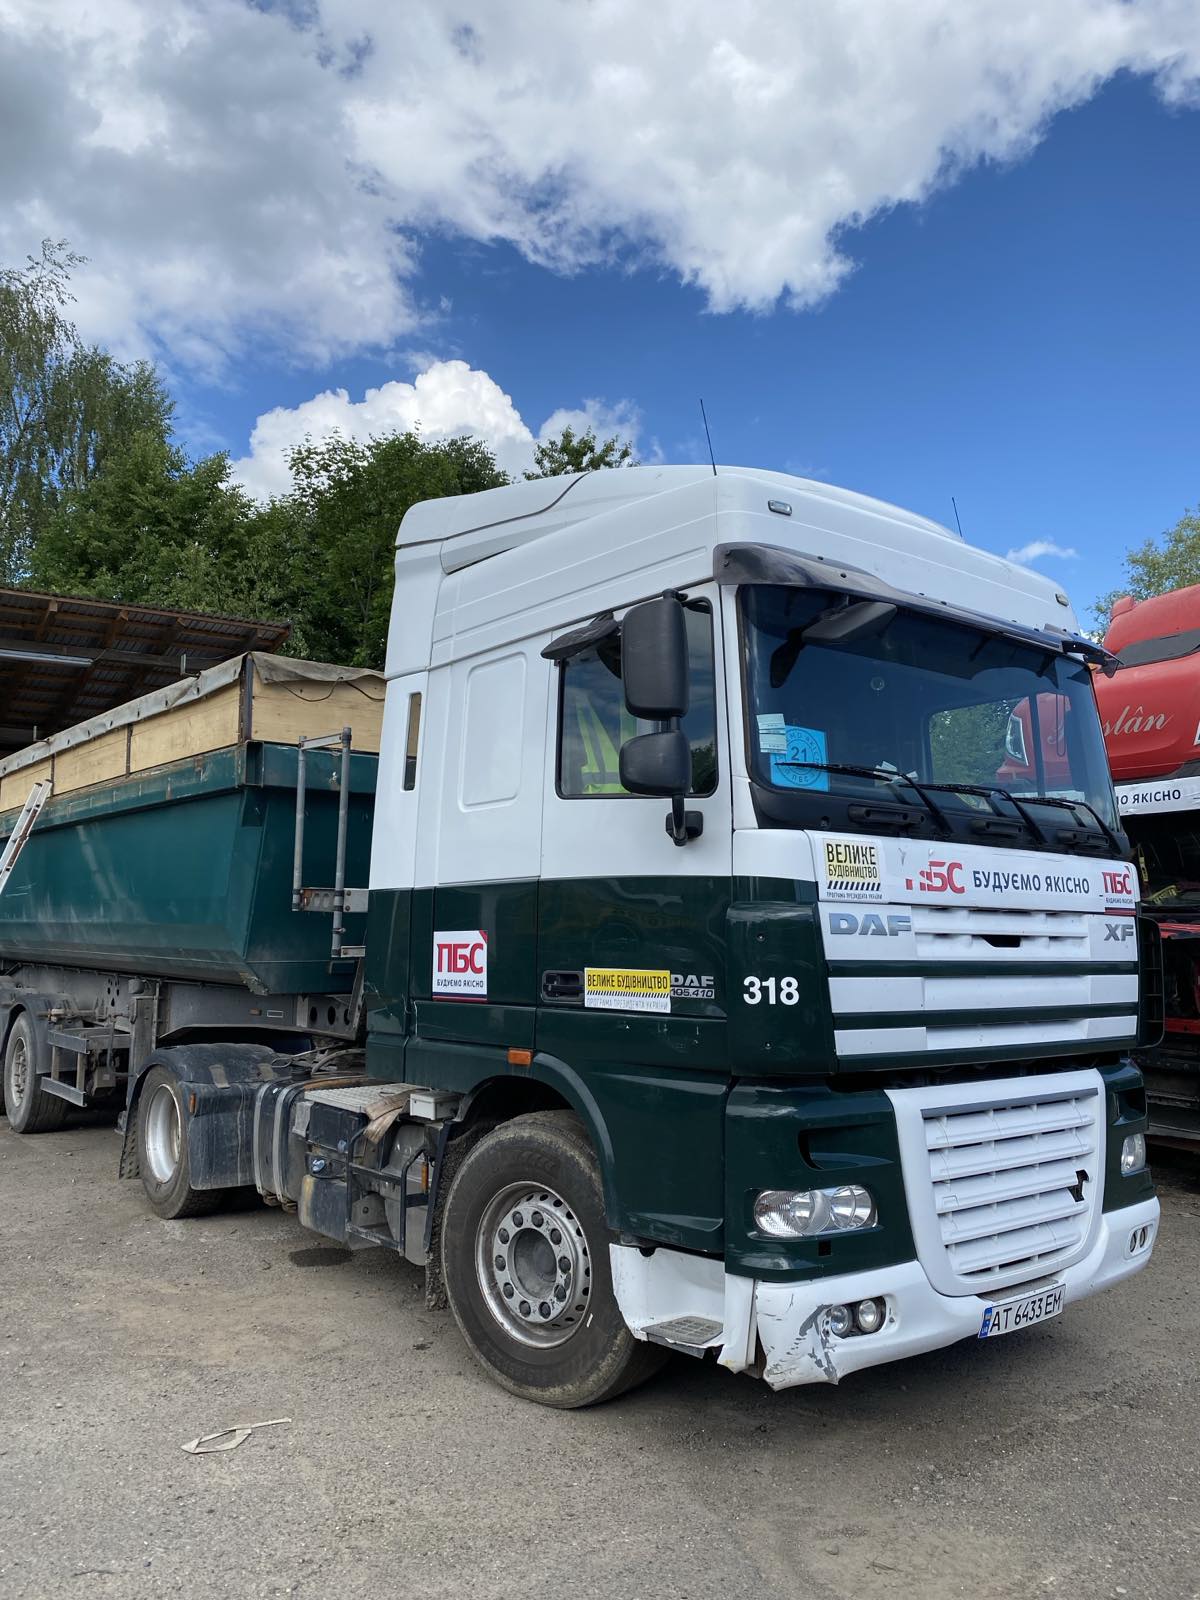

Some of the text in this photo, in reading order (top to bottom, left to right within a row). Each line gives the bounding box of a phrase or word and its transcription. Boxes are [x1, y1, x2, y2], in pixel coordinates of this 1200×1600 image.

[791, 746, 808, 762] 21
[1116, 789, 1181, 805] О ЯКІСНО
[826, 843, 877, 865] ВЕЛИКЕ
[828, 864, 878, 880] БУДІВНИЦТВО
[972, 870, 1041, 893] БУДУЄМО
[1044, 875, 1090, 894] ЯКІСНО
[1102, 872, 1132, 894] ПБС
[829, 912, 911, 936] DAF
[1104, 923, 1134, 941] XF
[437, 943, 484, 974] ПБС
[463, 980, 484, 988] ЯКІСНО
[587, 974, 668, 991] ВЕЛИКЕ БУДІВНИЦТВО
[671, 974, 714, 986] DAF
[671, 988, 714, 998] 105.410
[743, 975, 800, 1006] 318
[990, 1291, 1062, 1332] AT 6433 EM
